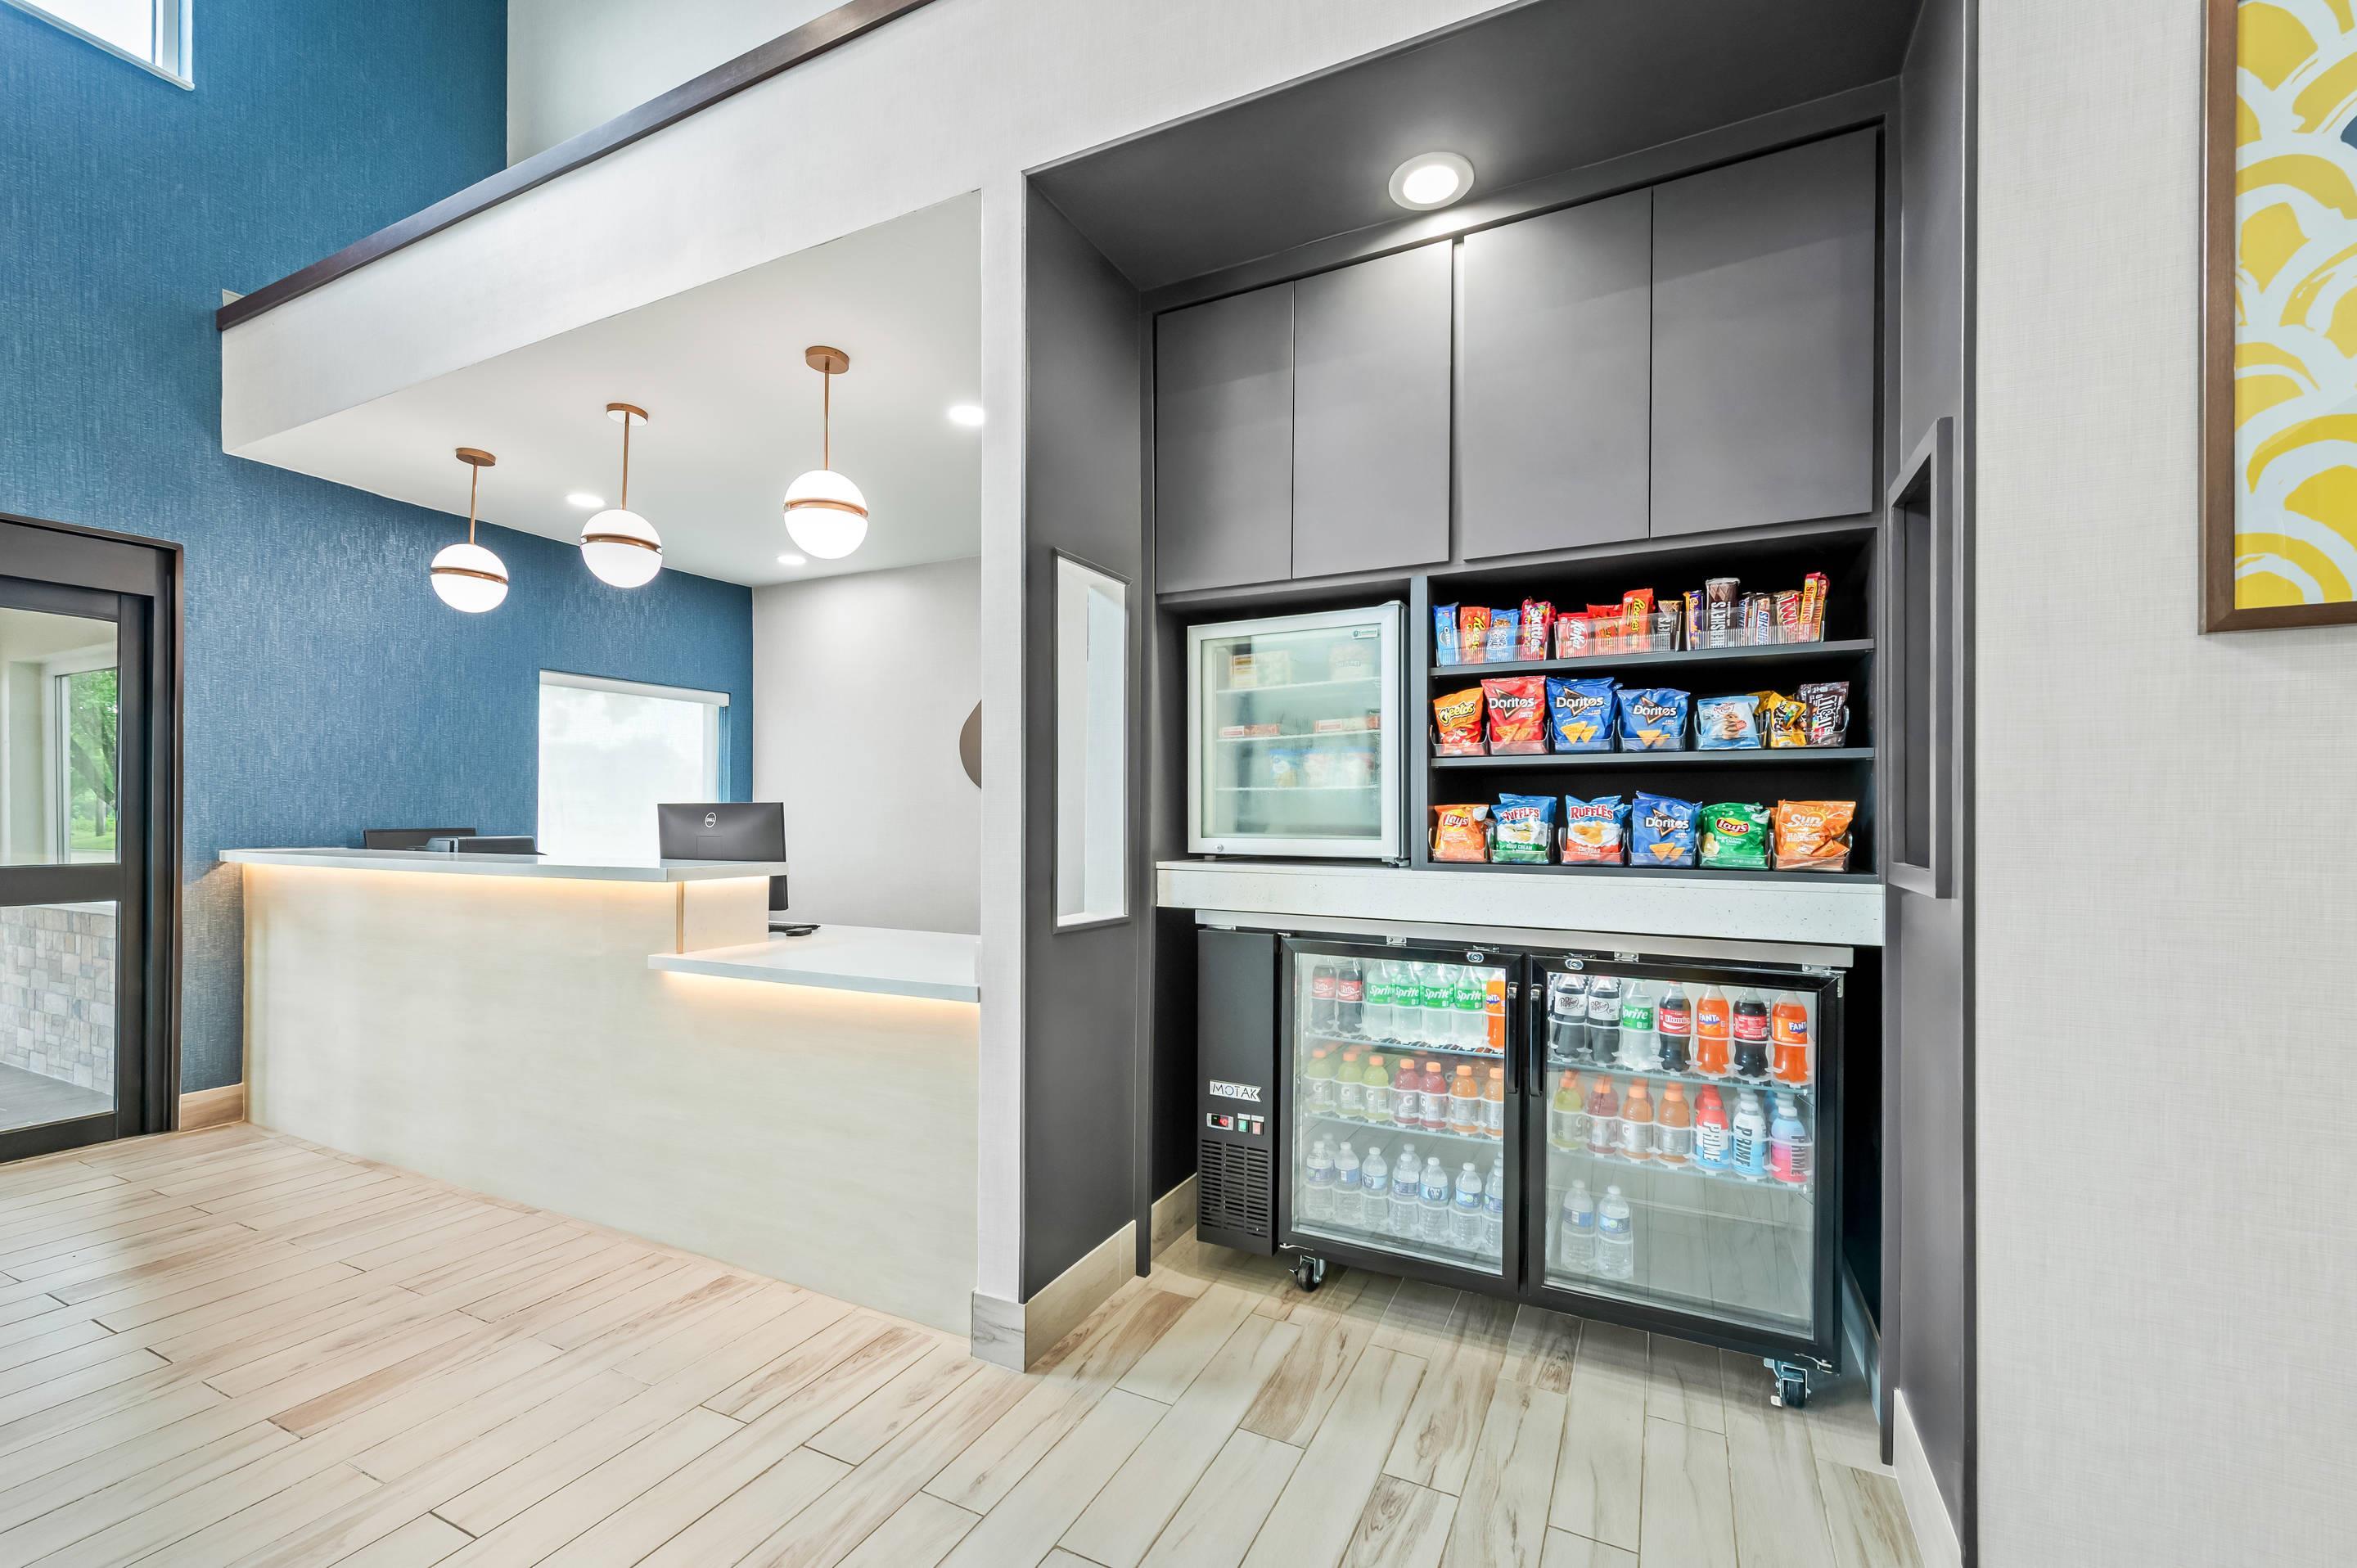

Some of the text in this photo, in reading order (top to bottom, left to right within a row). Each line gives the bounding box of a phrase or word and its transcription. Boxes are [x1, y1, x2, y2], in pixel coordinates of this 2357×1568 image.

[1802, 586, 1814, 624] Starburst
[1630, 597, 1646, 633] Reese's
[1489, 697, 1535, 710] Doritos
[1556, 696, 1604, 710] Doritos
[1439, 701, 1475, 724] Cheetos
[1633, 705, 1677, 717] Doritos
[1571, 804, 1613, 820] RUFFLES
[1444, 814, 1469, 827] Lay's
[1645, 817, 1689, 829] Doritos
[1717, 819, 1748, 832] Lay's
[1787, 813, 1822, 827] Sun
[1395, 987, 1419, 998] Sprite
[1424, 988, 1449, 999] Sprite
[1457, 990, 1482, 1001] Sprite
[1699, 1013, 1720, 1022] FANTA
[1212, 1083, 1257, 1100] MOTAK
[1313, 1082, 1322, 1093] G
[1341, 1087, 1350, 1097] G
[1366, 1090, 1375, 1101] G
[1403, 1095, 1413, 1106] G
[1703, 1122, 1722, 1162] PRIME
[1736, 1125, 1753, 1167] PRIME
[1791, 1135, 1807, 1177] PRIME
